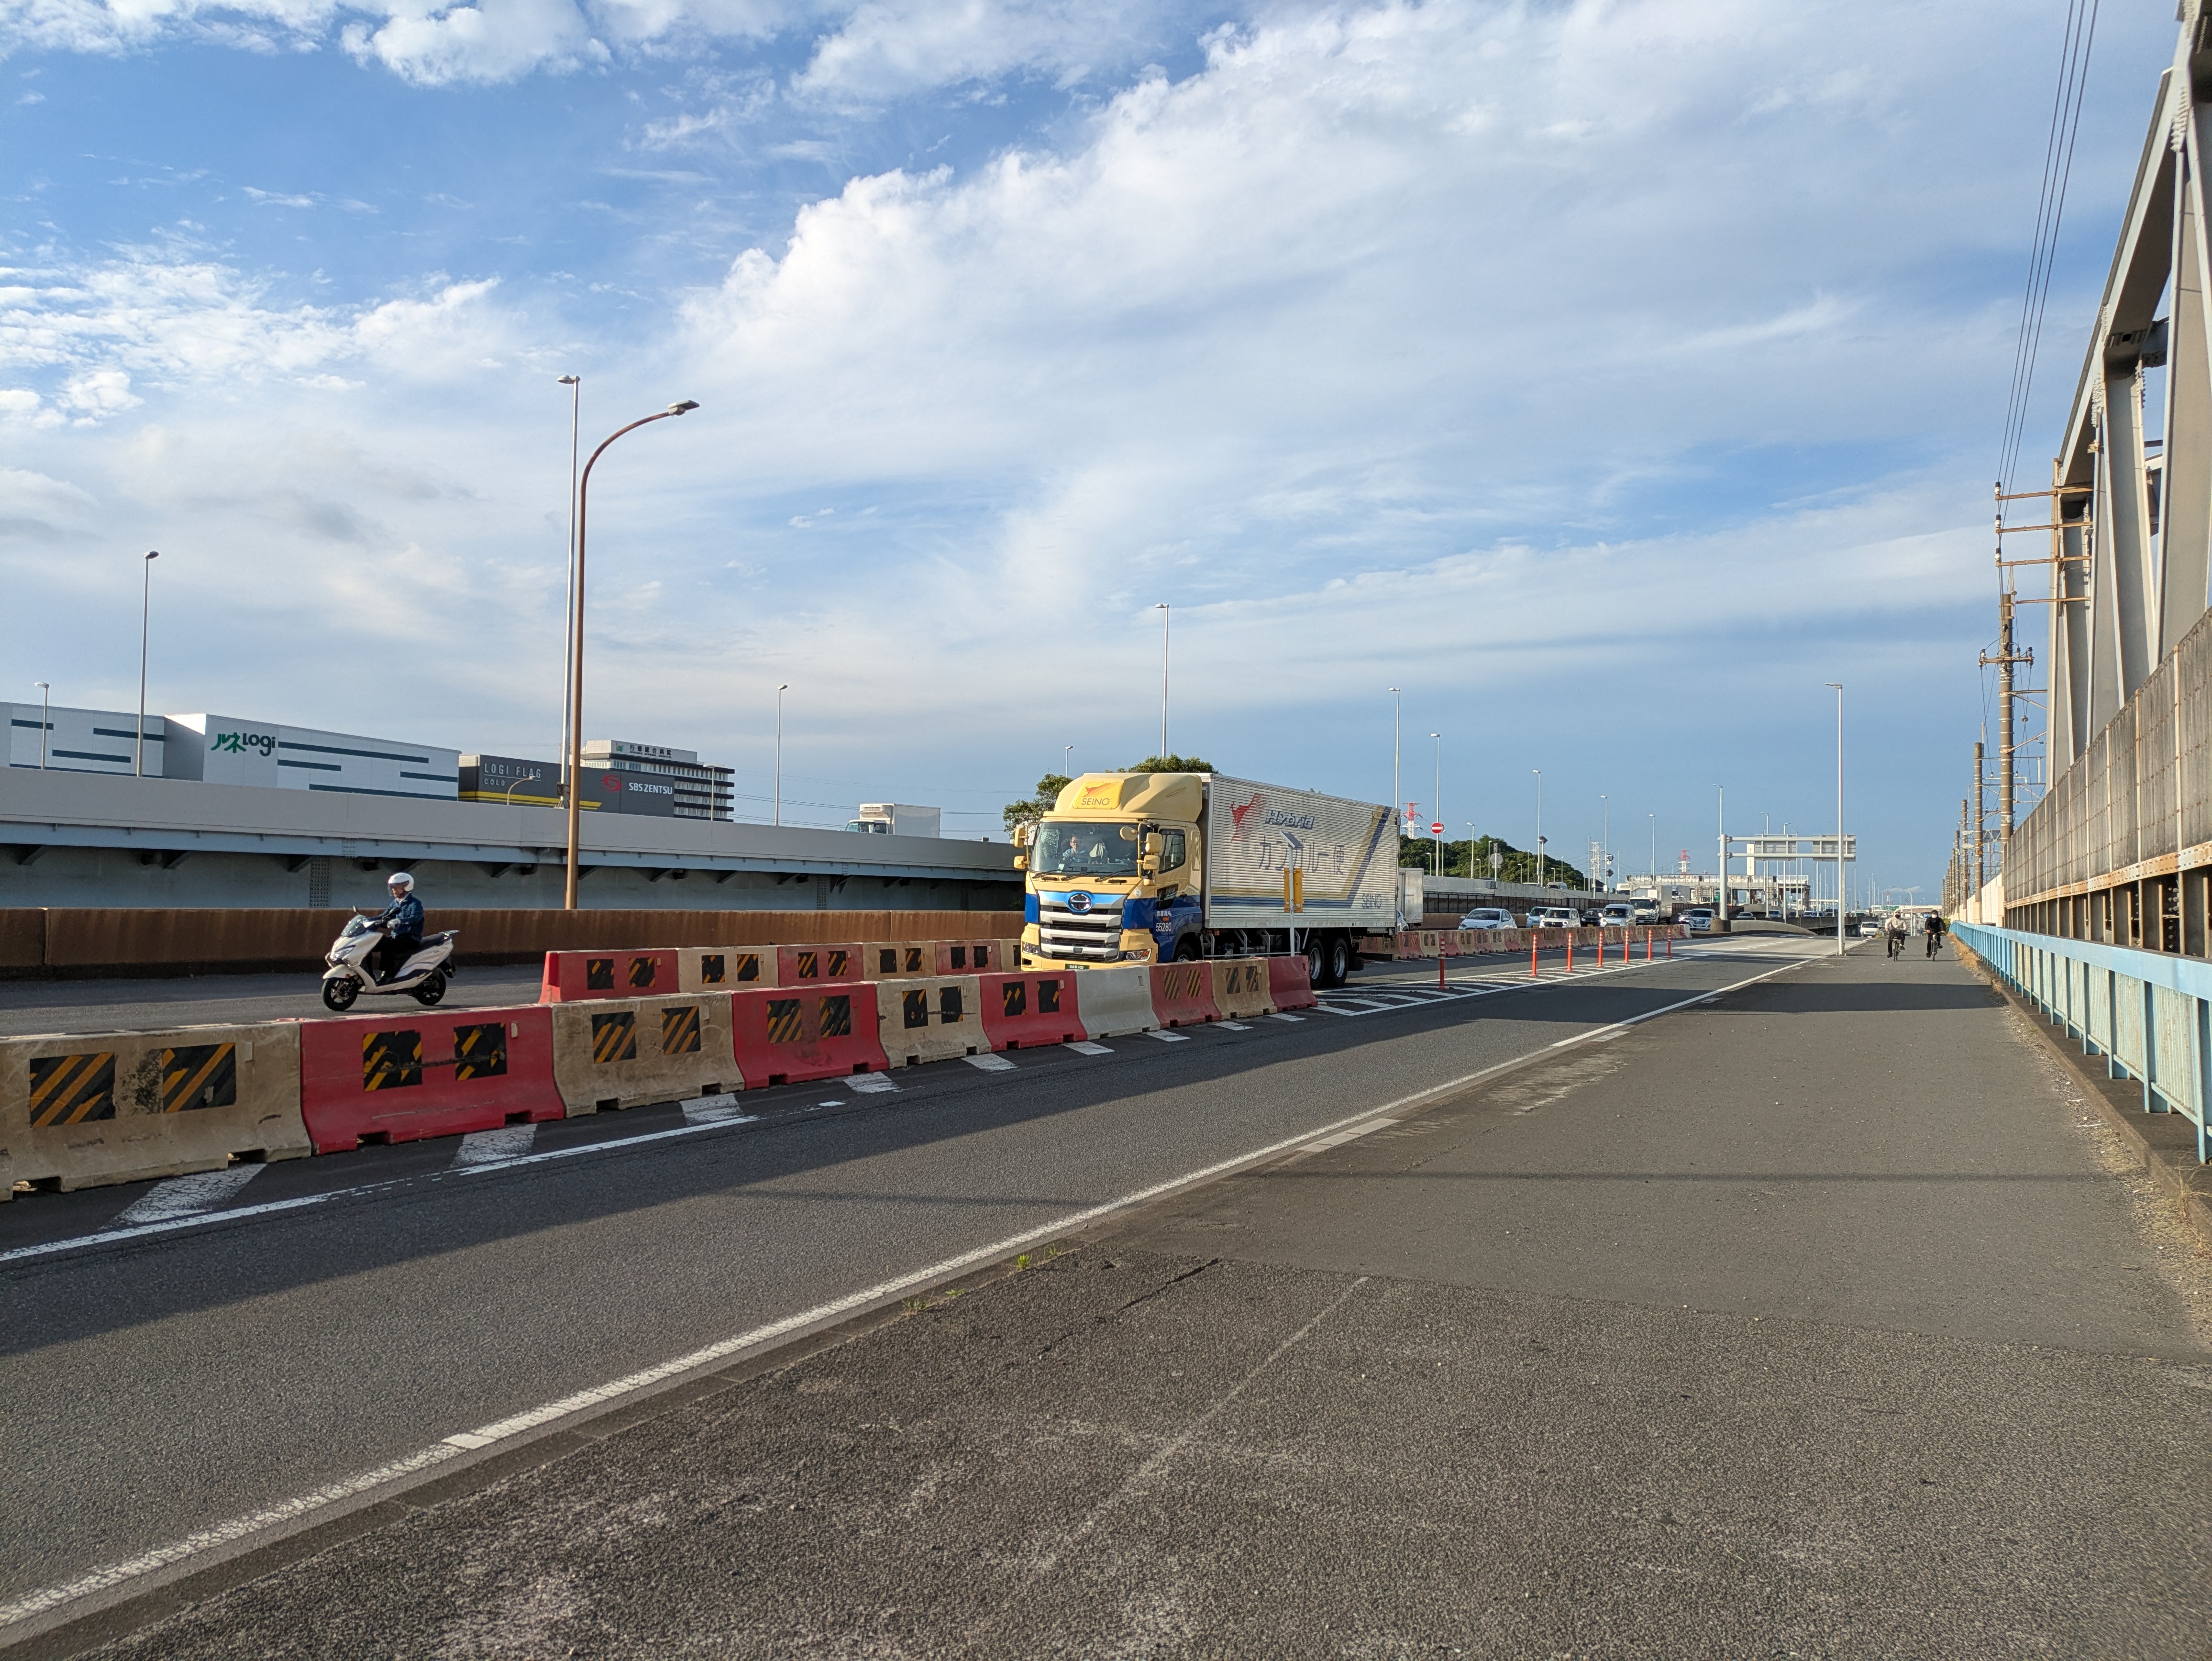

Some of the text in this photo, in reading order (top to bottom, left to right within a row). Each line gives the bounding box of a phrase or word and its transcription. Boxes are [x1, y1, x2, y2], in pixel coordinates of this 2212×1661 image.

[484, 763, 541, 778] LOGI FLAG
[484, 778, 505, 786] COLD
[629, 782, 673, 795] SBS ZENTSU
[1081, 797, 1110, 806] SEINO
[1265, 810, 1315, 830] Hybrid
[1362, 893, 1382, 909] SEINO
[1156, 922, 1172, 932] 55280
